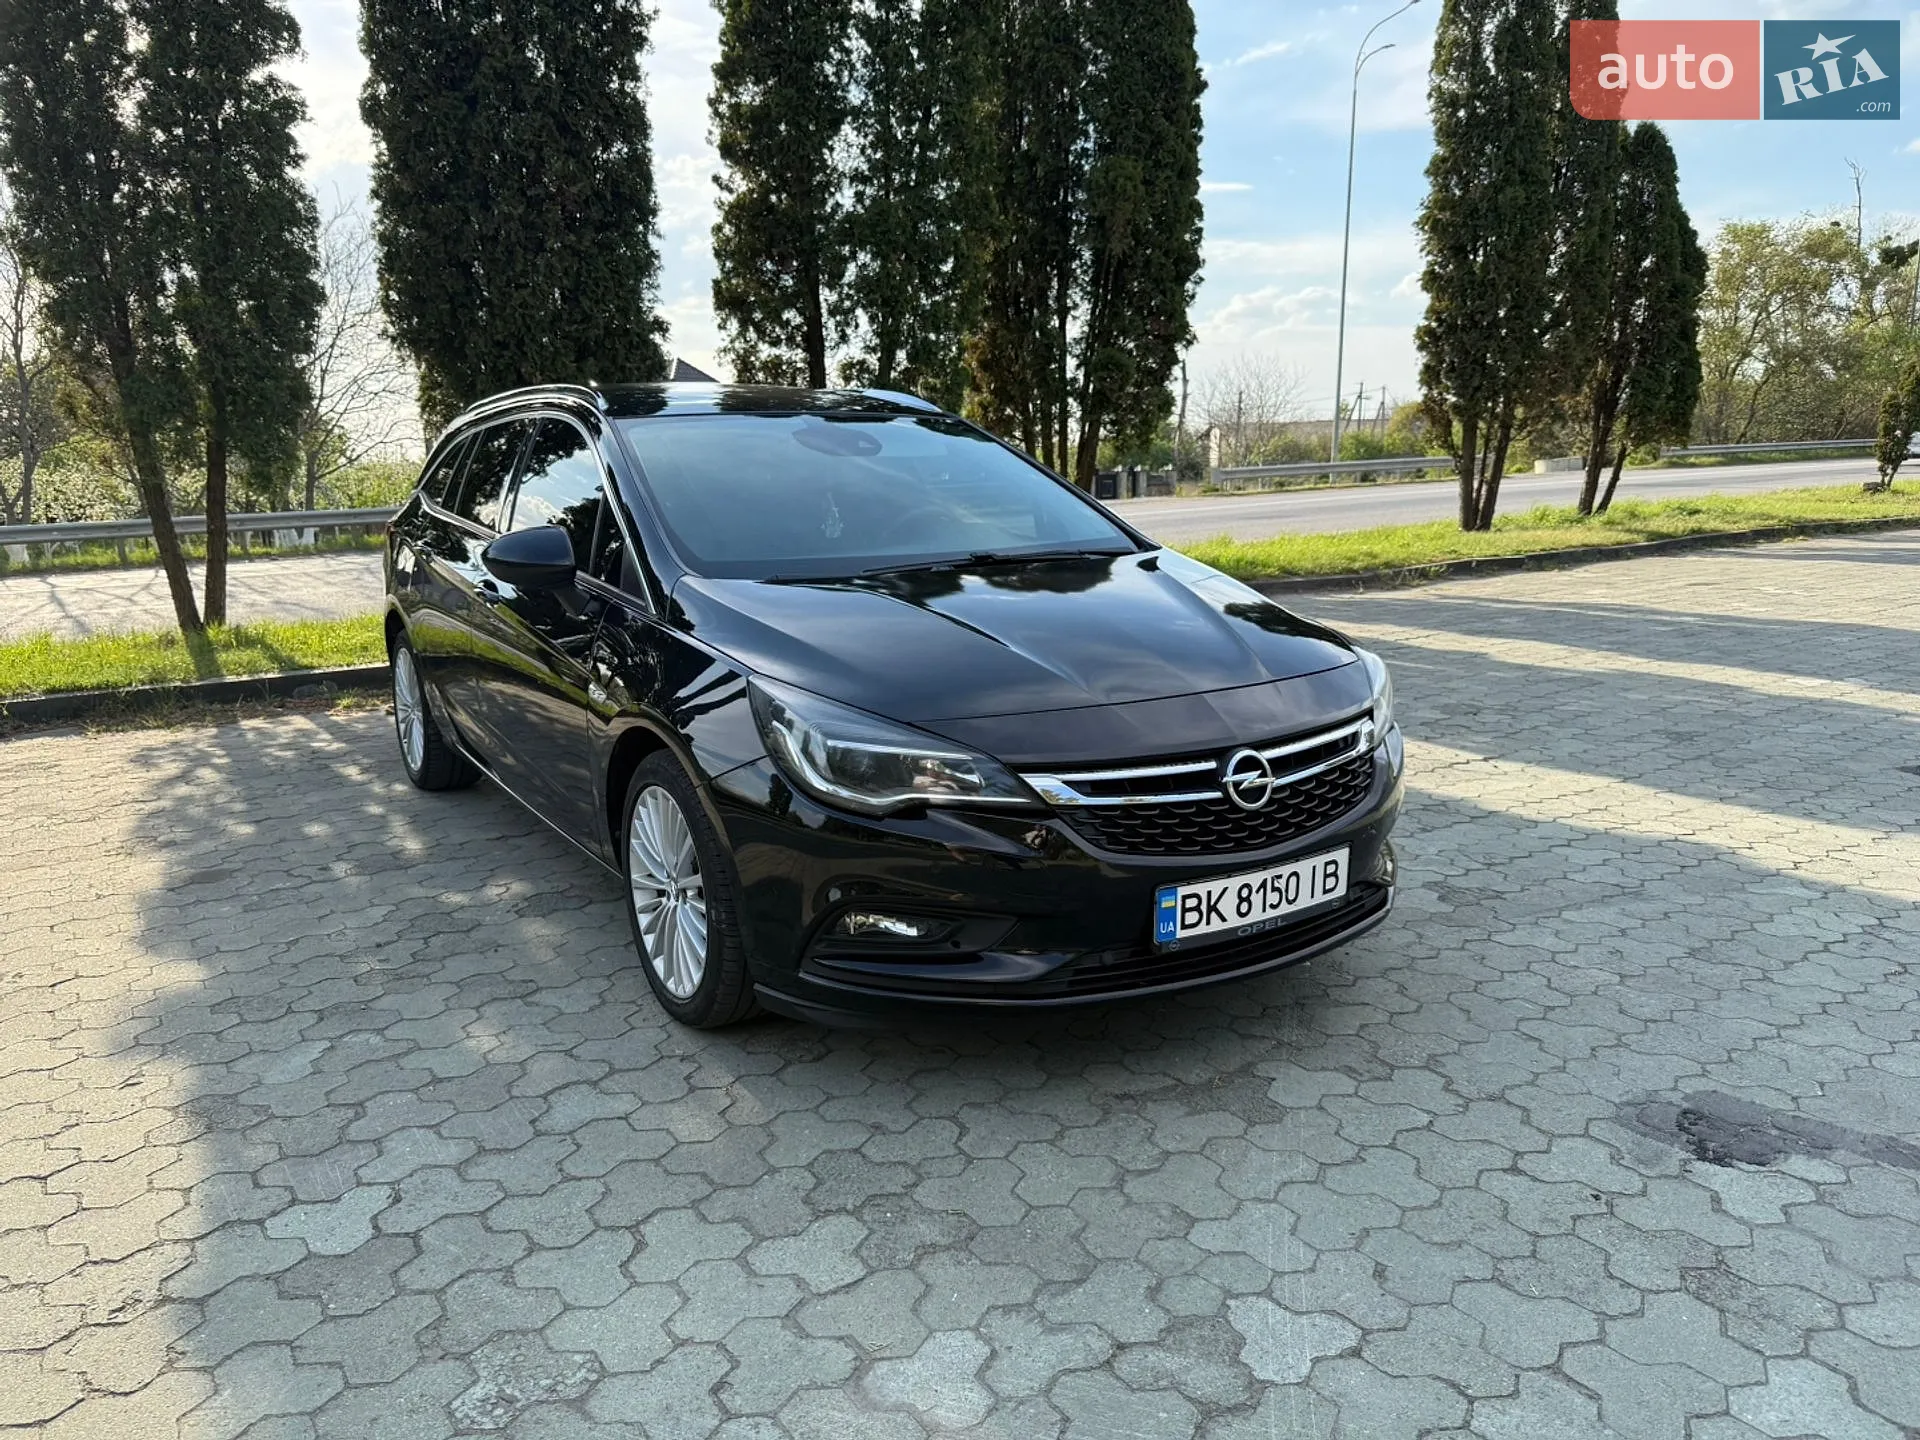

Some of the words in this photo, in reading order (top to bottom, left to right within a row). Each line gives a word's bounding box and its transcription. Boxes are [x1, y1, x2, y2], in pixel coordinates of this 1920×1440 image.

[1179, 886, 1229, 931] BK
[1235, 870, 1300, 919] 8150
[1310, 858, 1340, 899] IB
[1160, 921, 1175, 934] UA
[1236, 917, 1288, 936] OPEL
